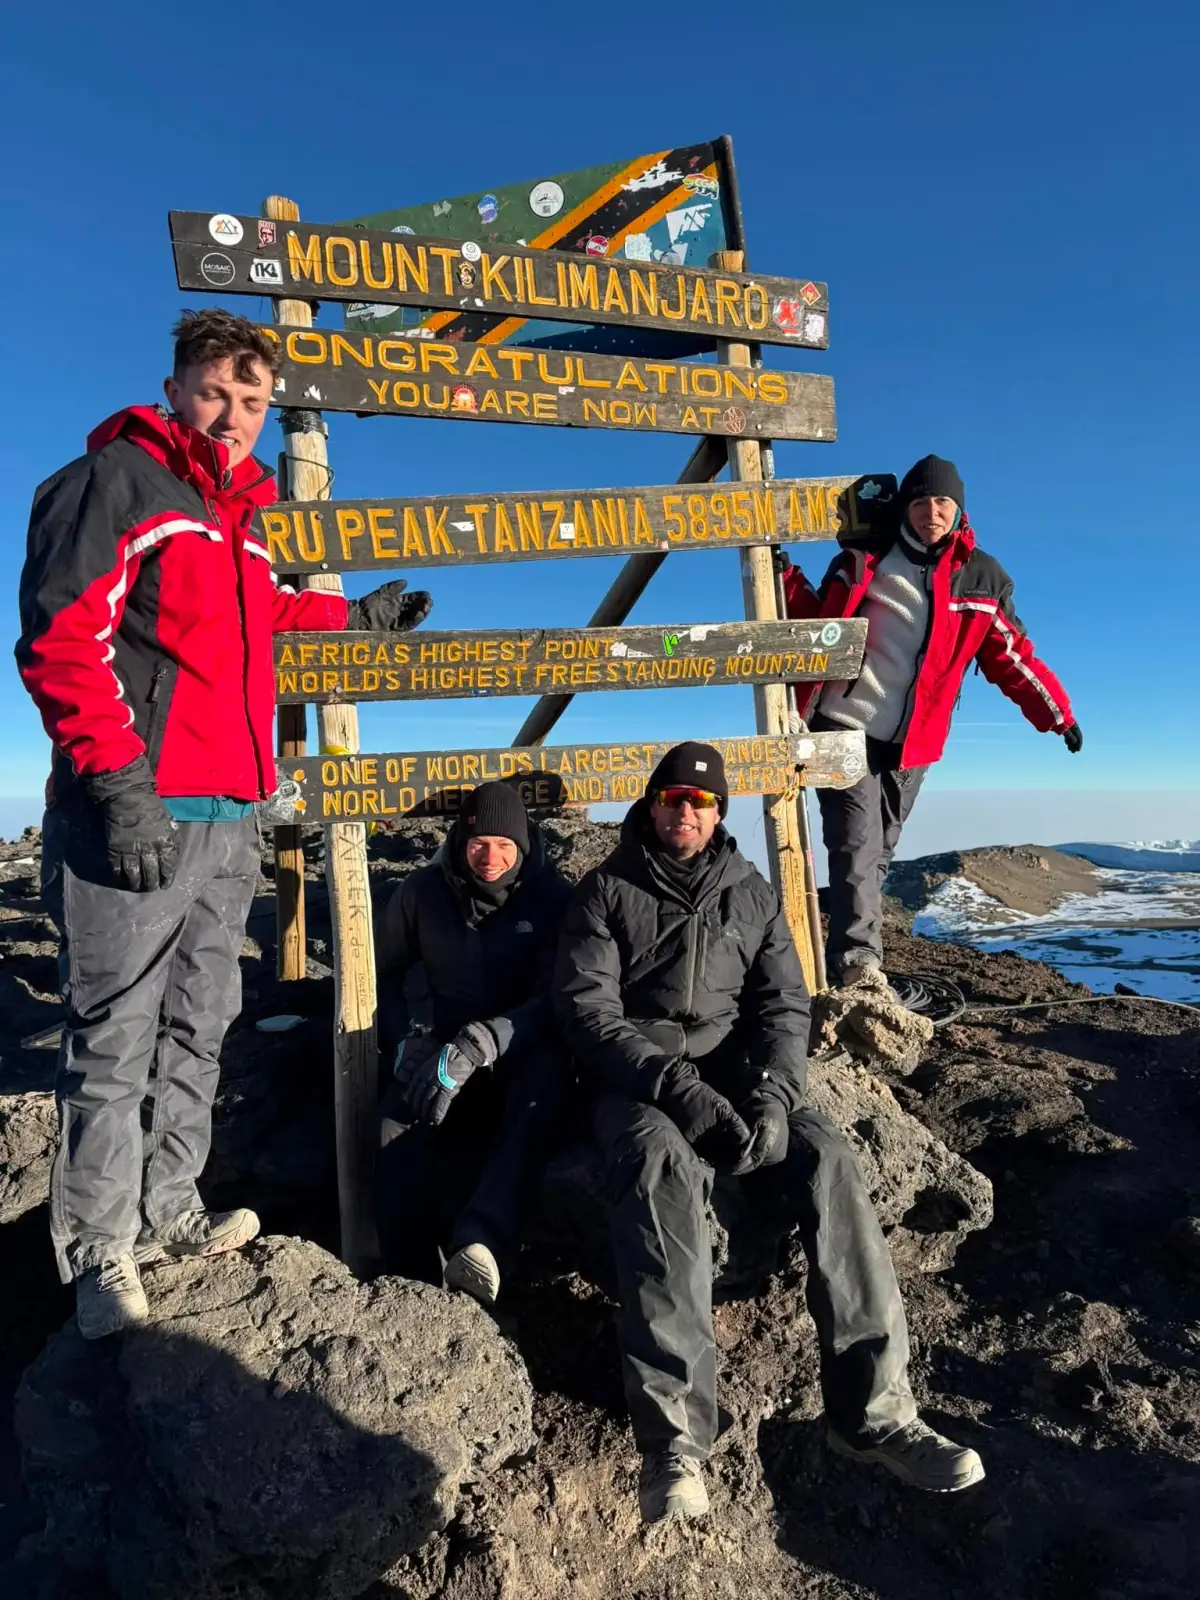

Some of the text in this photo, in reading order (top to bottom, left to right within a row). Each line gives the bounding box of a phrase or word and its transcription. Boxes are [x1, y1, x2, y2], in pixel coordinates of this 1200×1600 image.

[204, 263, 231, 272] MOSAIC
[286, 232, 769, 330] MOUNT KILIMANJARO
[367, 378, 450, 410] YOU
[480, 388, 558, 419] ARE
[582, 399, 657, 427] NOW
[681, 407, 721, 430] AT
[464, 497, 655, 553] TANZANIA
[662, 490, 777, 542] 5895M
[788, 484, 872, 535] AMSL
[279, 652, 830, 694] WORLD'S HIGHEST FREE STANDING MOUNTAIN
[420, 640, 532, 664] HIGHEST
[545, 636, 615, 660] POINT
[321, 756, 378, 787] ONE
[386, 757, 417, 783] OF
[540, 743, 658, 776] LARGEST
[664, 738, 790, 768] ANOES
[323, 786, 416, 817] WORLD
[424, 779, 551, 810] HERGE
[561, 774, 604, 802] AND
